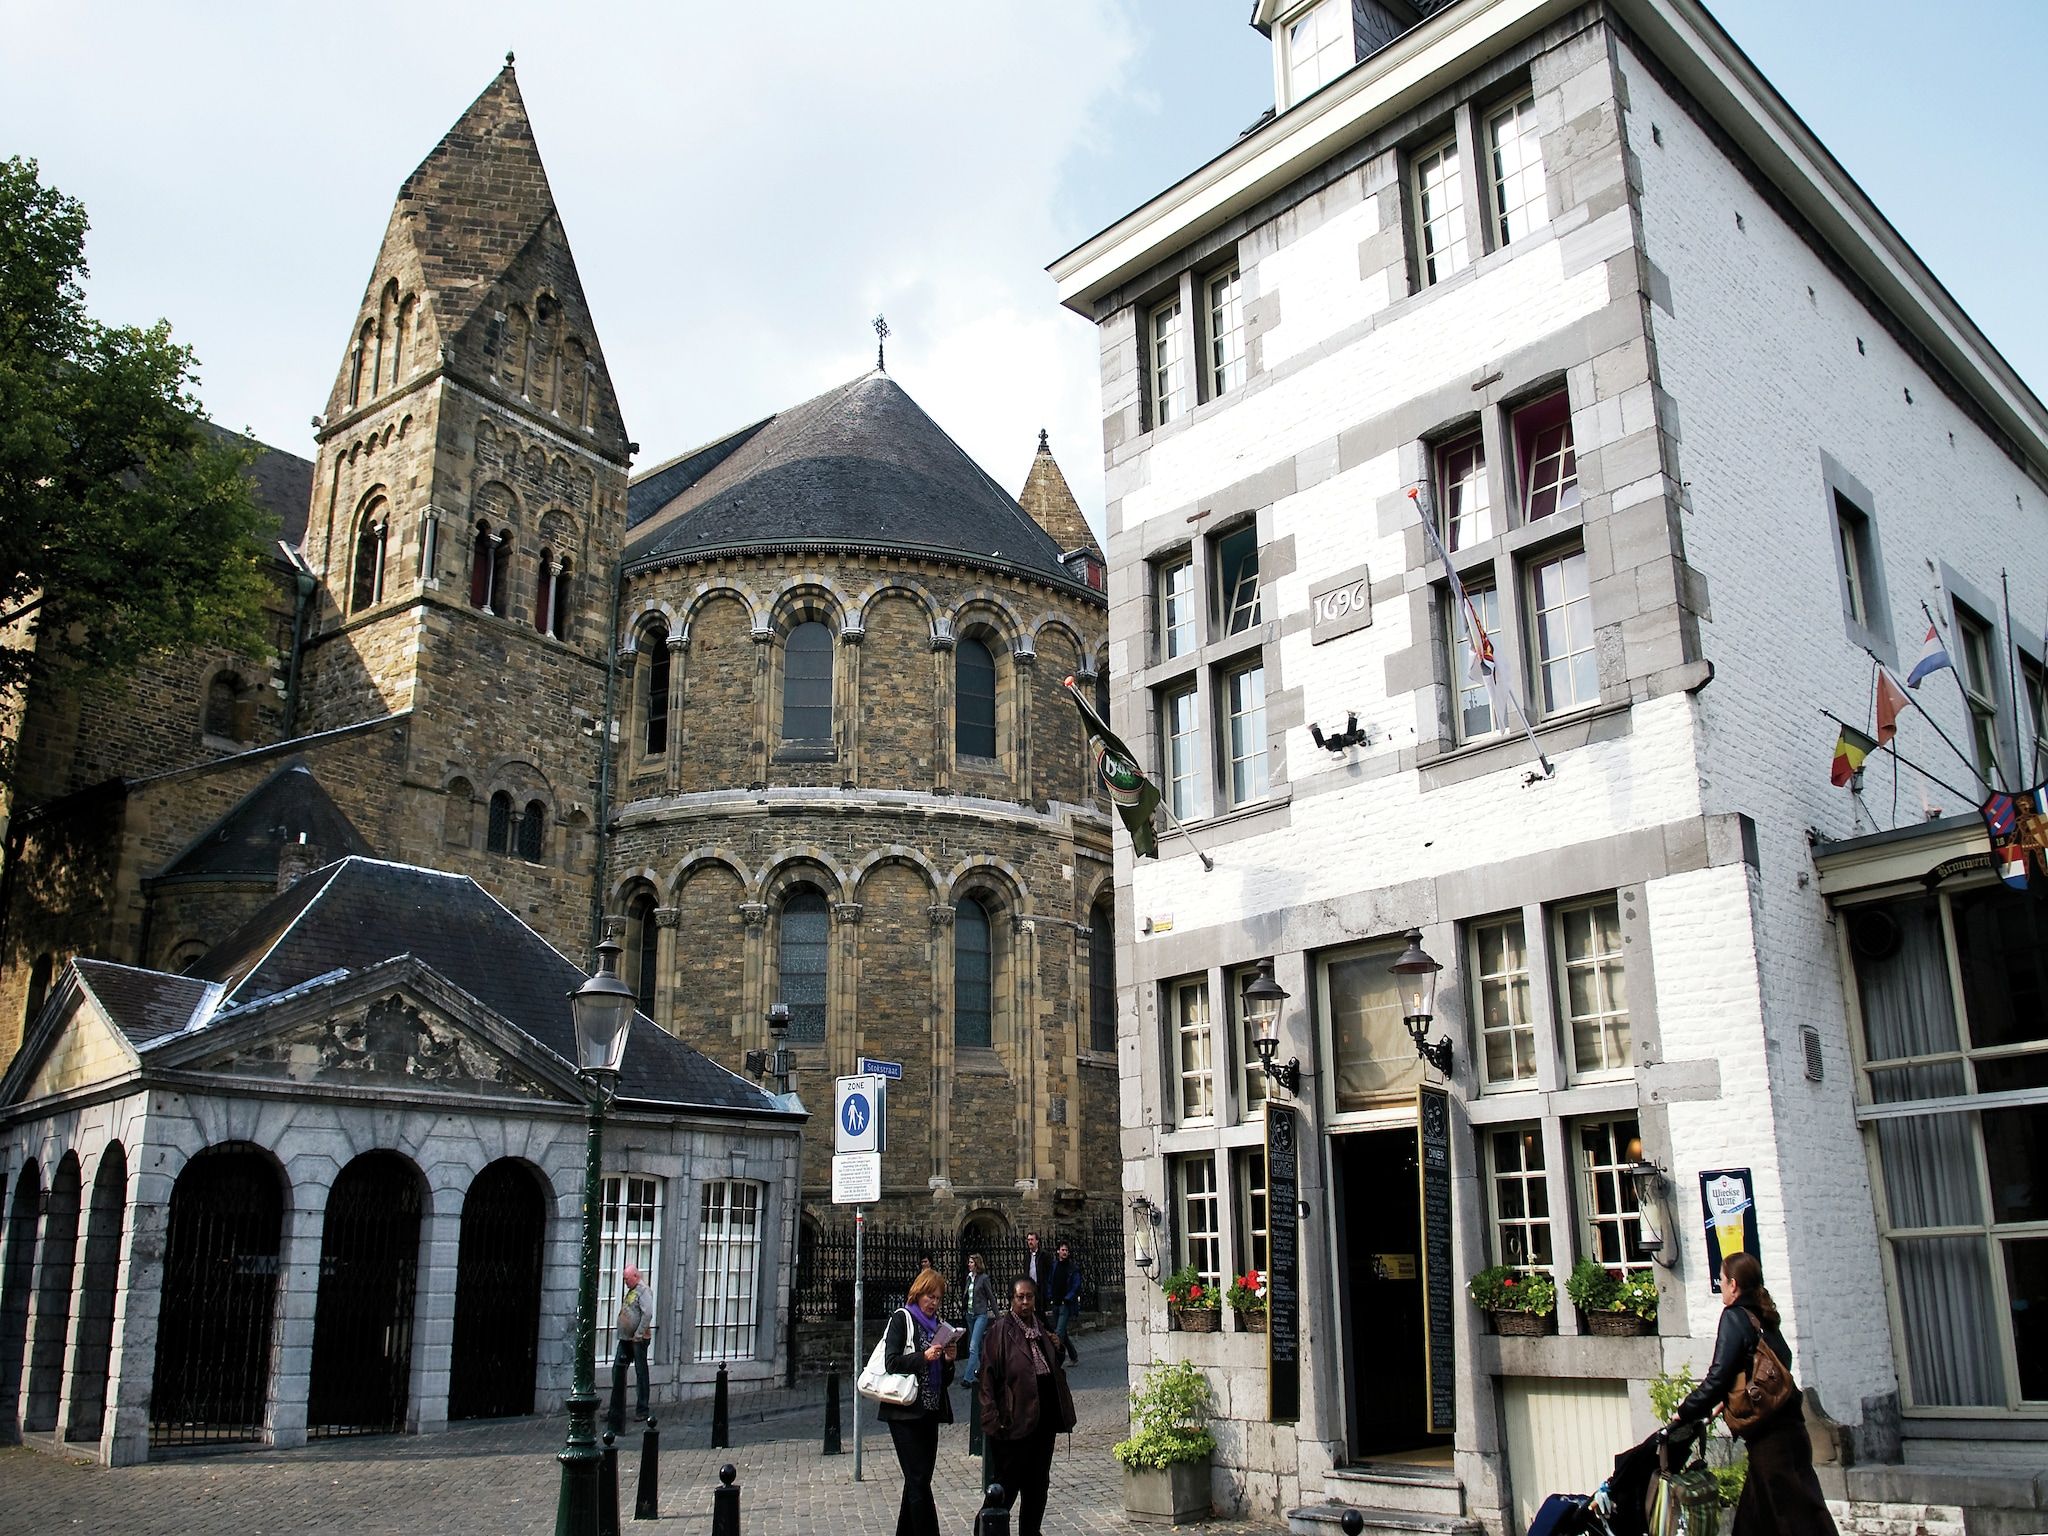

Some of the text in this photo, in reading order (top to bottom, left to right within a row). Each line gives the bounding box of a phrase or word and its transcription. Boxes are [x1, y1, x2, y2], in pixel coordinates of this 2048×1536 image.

[1314, 582, 1365, 628] 1696
[847, 1081, 865, 1091] ZONE
[1717, 1197, 1736, 1206] Witte
